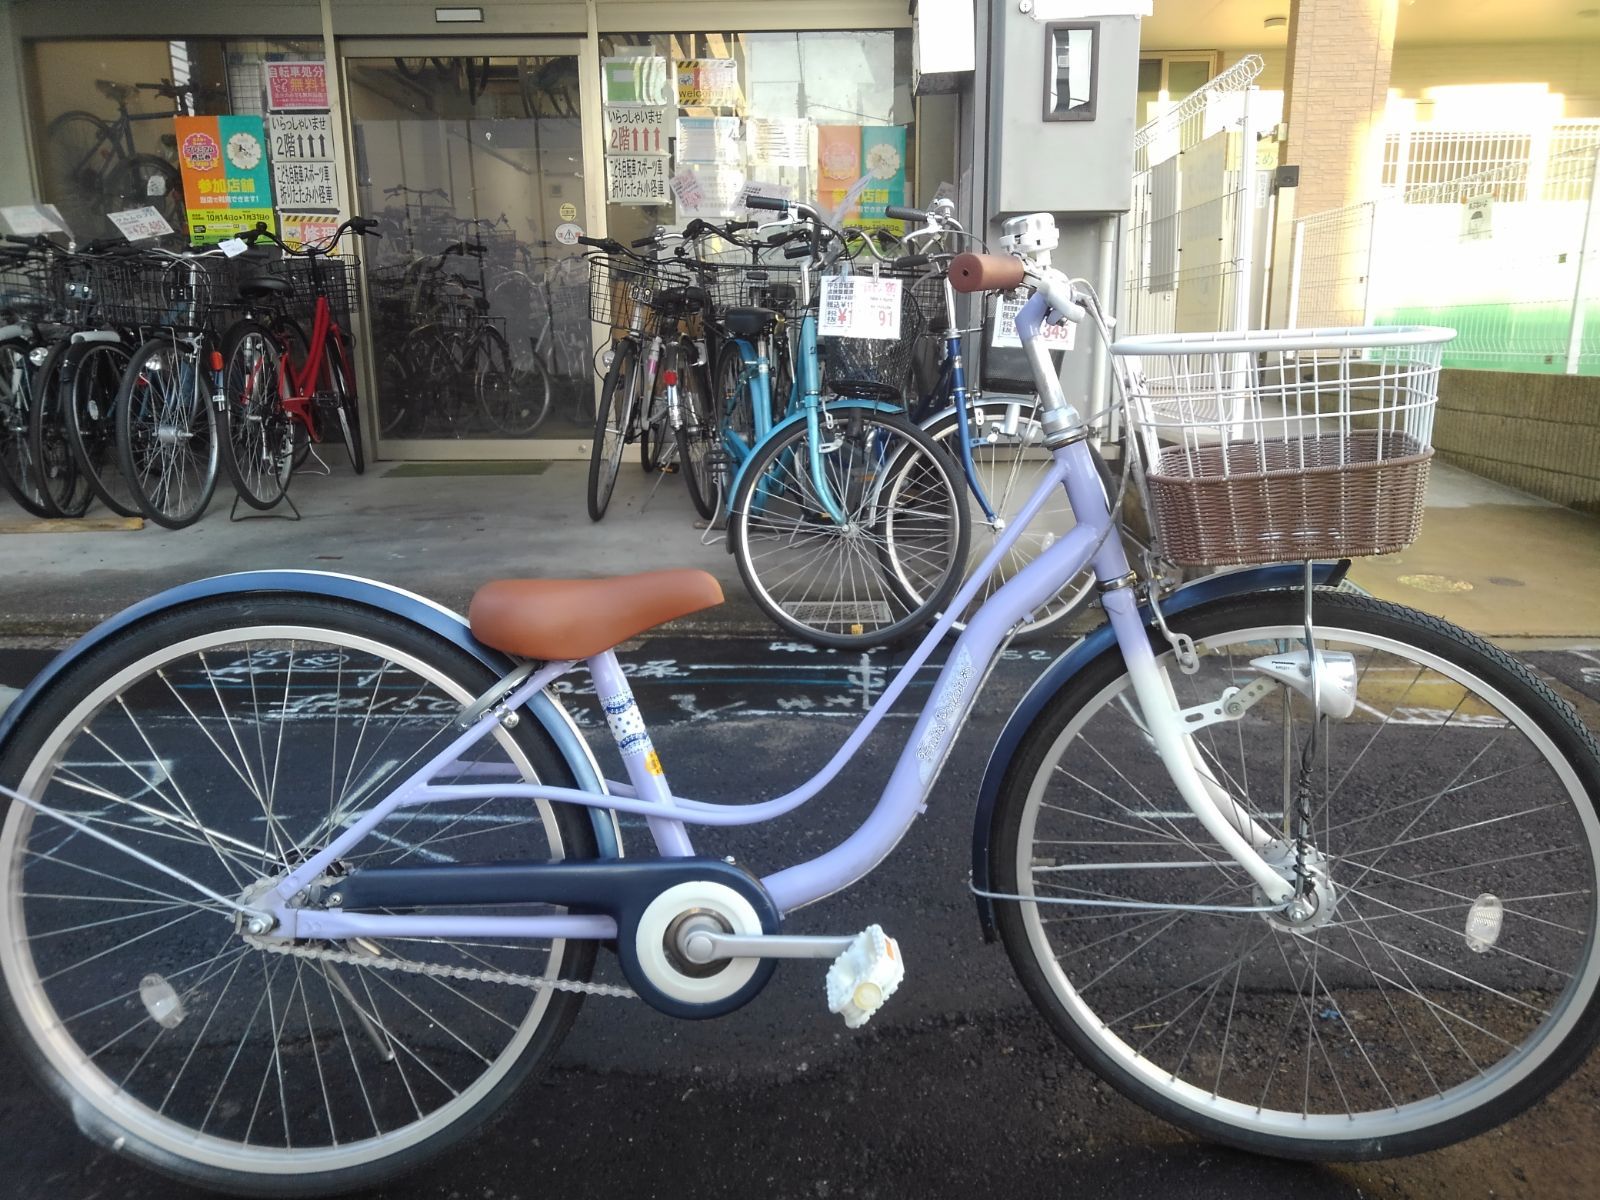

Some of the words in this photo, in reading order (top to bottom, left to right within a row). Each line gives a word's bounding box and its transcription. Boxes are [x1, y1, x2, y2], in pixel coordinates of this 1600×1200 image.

[272, 115, 326, 131] いらっしゃいませ
[608, 109, 662, 124] いらっしゃいませ
[276, 133, 296, 158] 2階
[611, 126, 630, 151] 2階
[197, 178, 256, 193] 参加店舗
